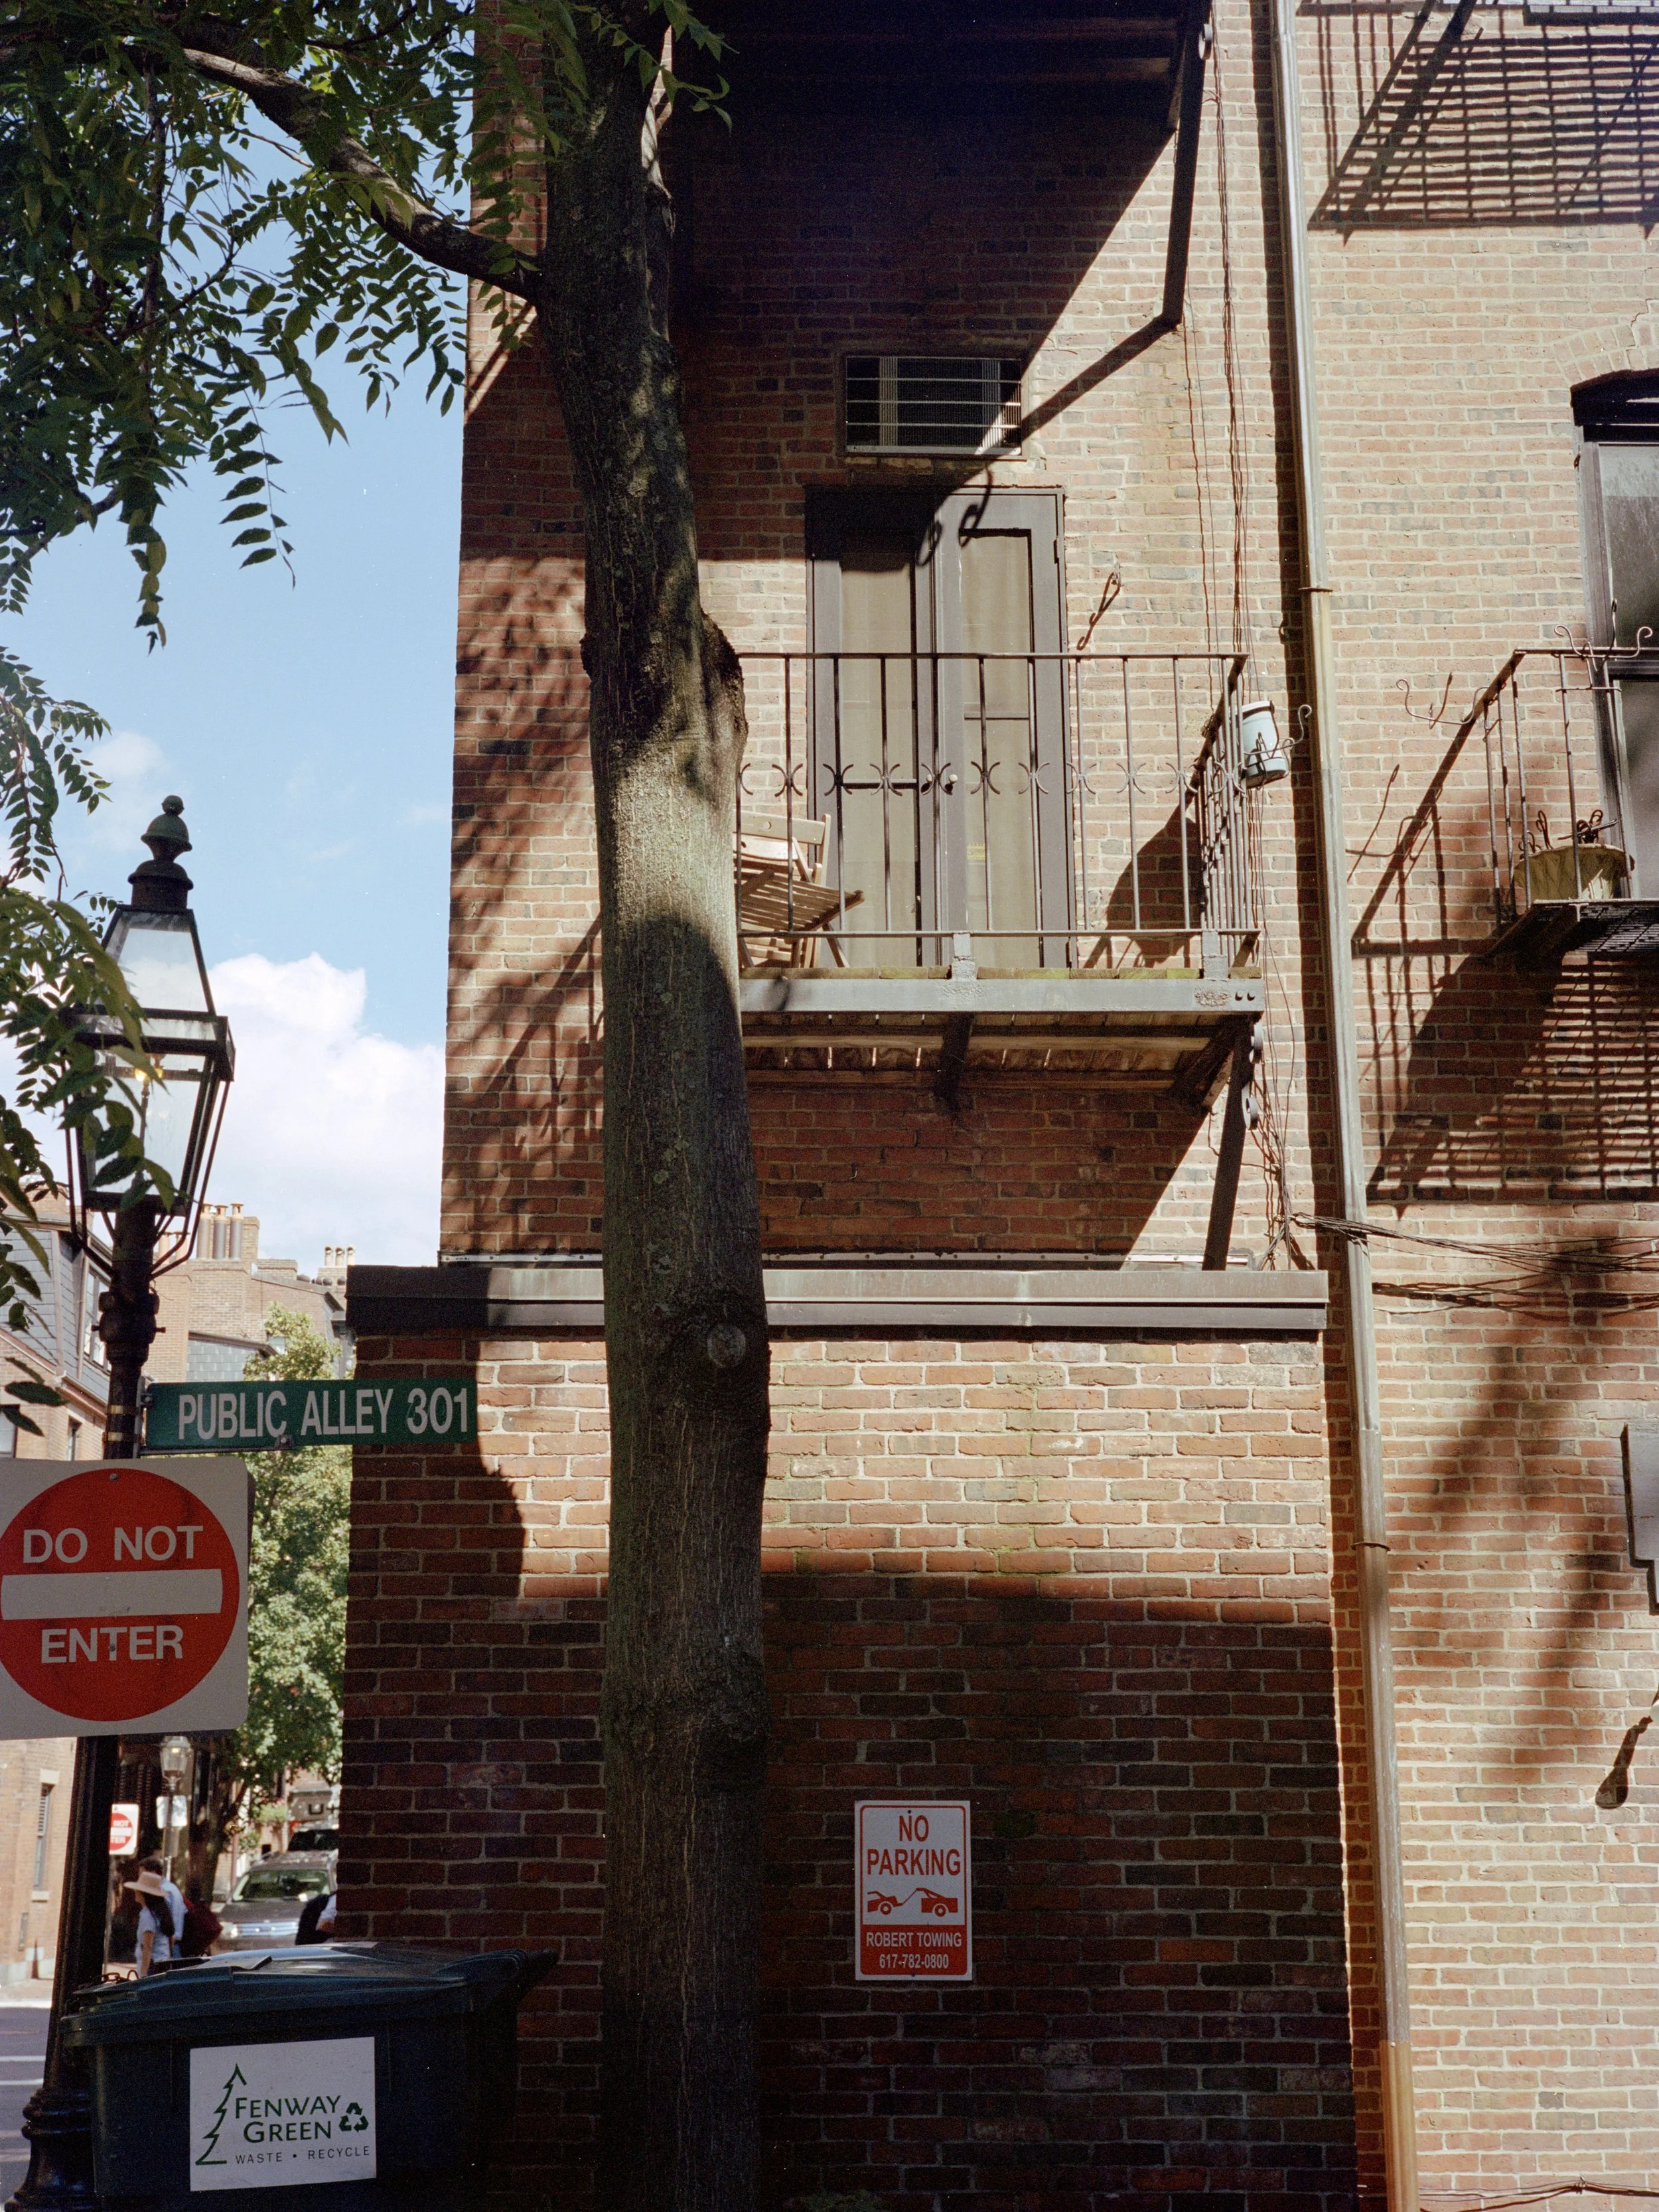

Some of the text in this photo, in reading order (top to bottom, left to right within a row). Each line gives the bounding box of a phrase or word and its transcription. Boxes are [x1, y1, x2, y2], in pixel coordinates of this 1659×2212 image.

[179, 1387, 468, 1440] PUBLIC ALLEY 301
[23, 1525, 204, 1564] DO NOT
[41, 1625, 184, 1663] ENTER
[899, 1814, 929, 1842] NO
[867, 1848, 961, 1876] PARKING
[866, 1932, 962, 1947] ROBERT TOWING
[879, 1953, 949, 1969] 617-782-0800
[235, 2095, 342, 2119] FENWAY
[244, 2120, 331, 2144] GREEN
[236, 2146, 370, 2164] WASTE RECYCLE
